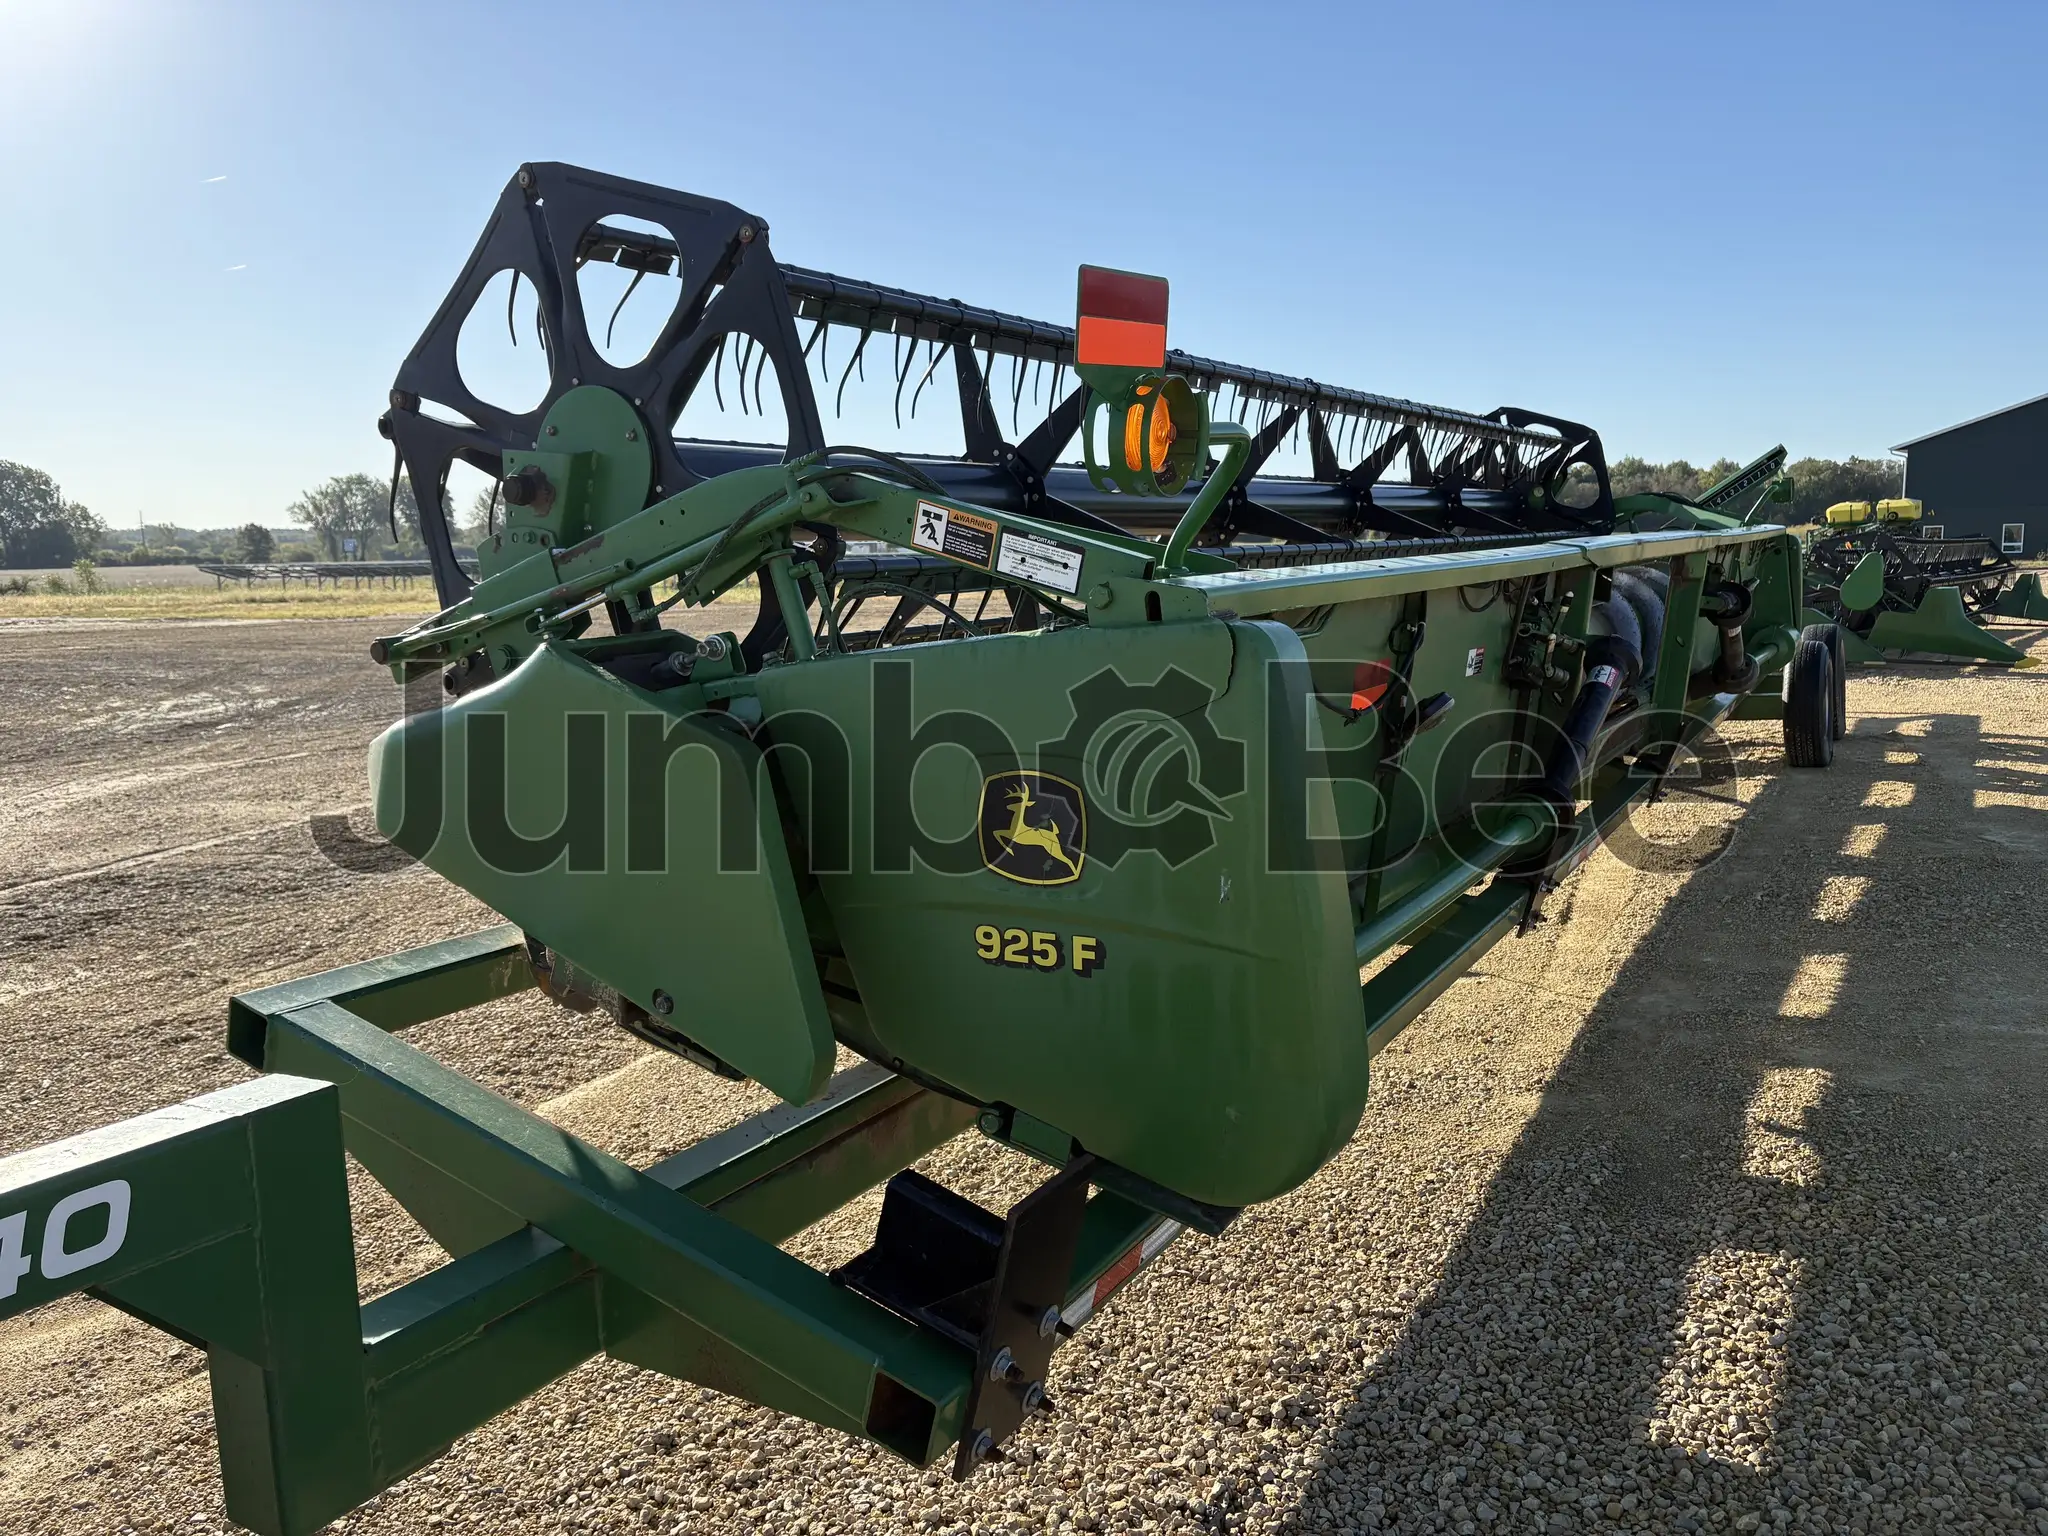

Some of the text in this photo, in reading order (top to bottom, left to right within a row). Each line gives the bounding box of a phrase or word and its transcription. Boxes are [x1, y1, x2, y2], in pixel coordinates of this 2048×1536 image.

[958, 515, 993, 530] WARNING
[1027, 534, 1058, 546] IMPORTANT
[974, 924, 1102, 975] 925 F
